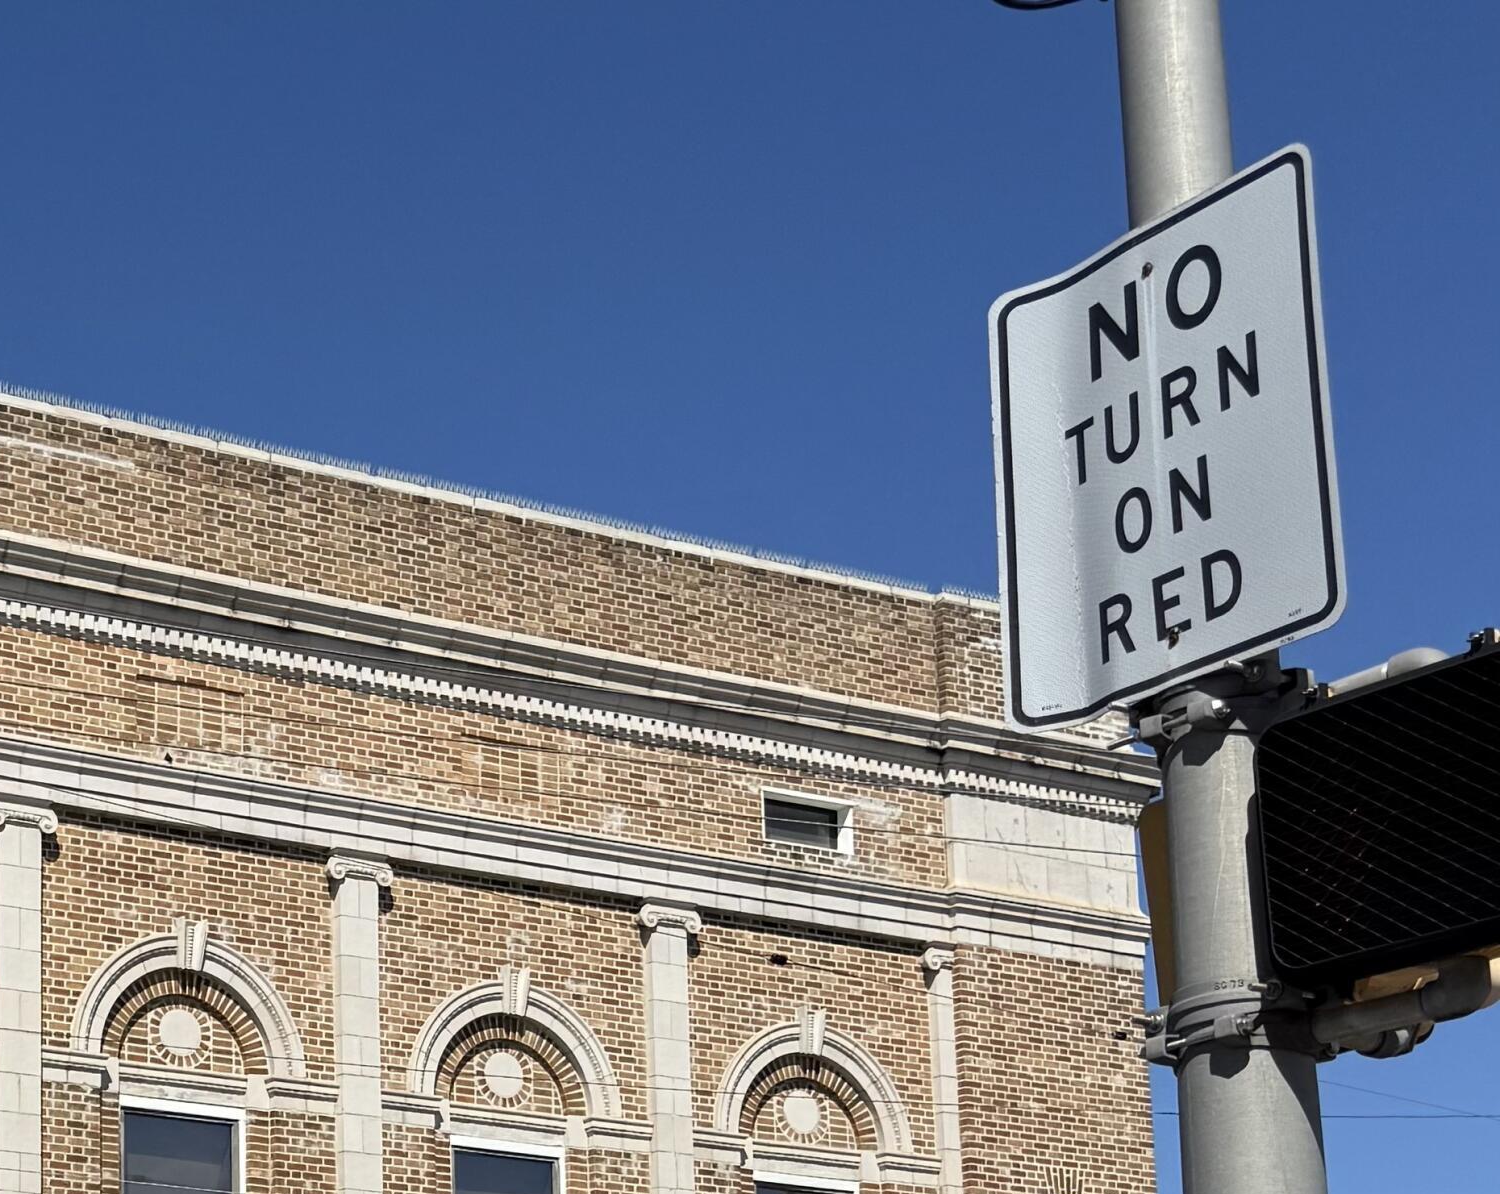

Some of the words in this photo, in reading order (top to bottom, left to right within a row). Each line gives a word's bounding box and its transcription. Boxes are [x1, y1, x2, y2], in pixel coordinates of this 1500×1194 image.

[1088, 243, 1222, 382] NO
[1064, 331, 1260, 485] TURN
[1114, 454, 1212, 554] ON
[1098, 548, 1244, 665] RED
